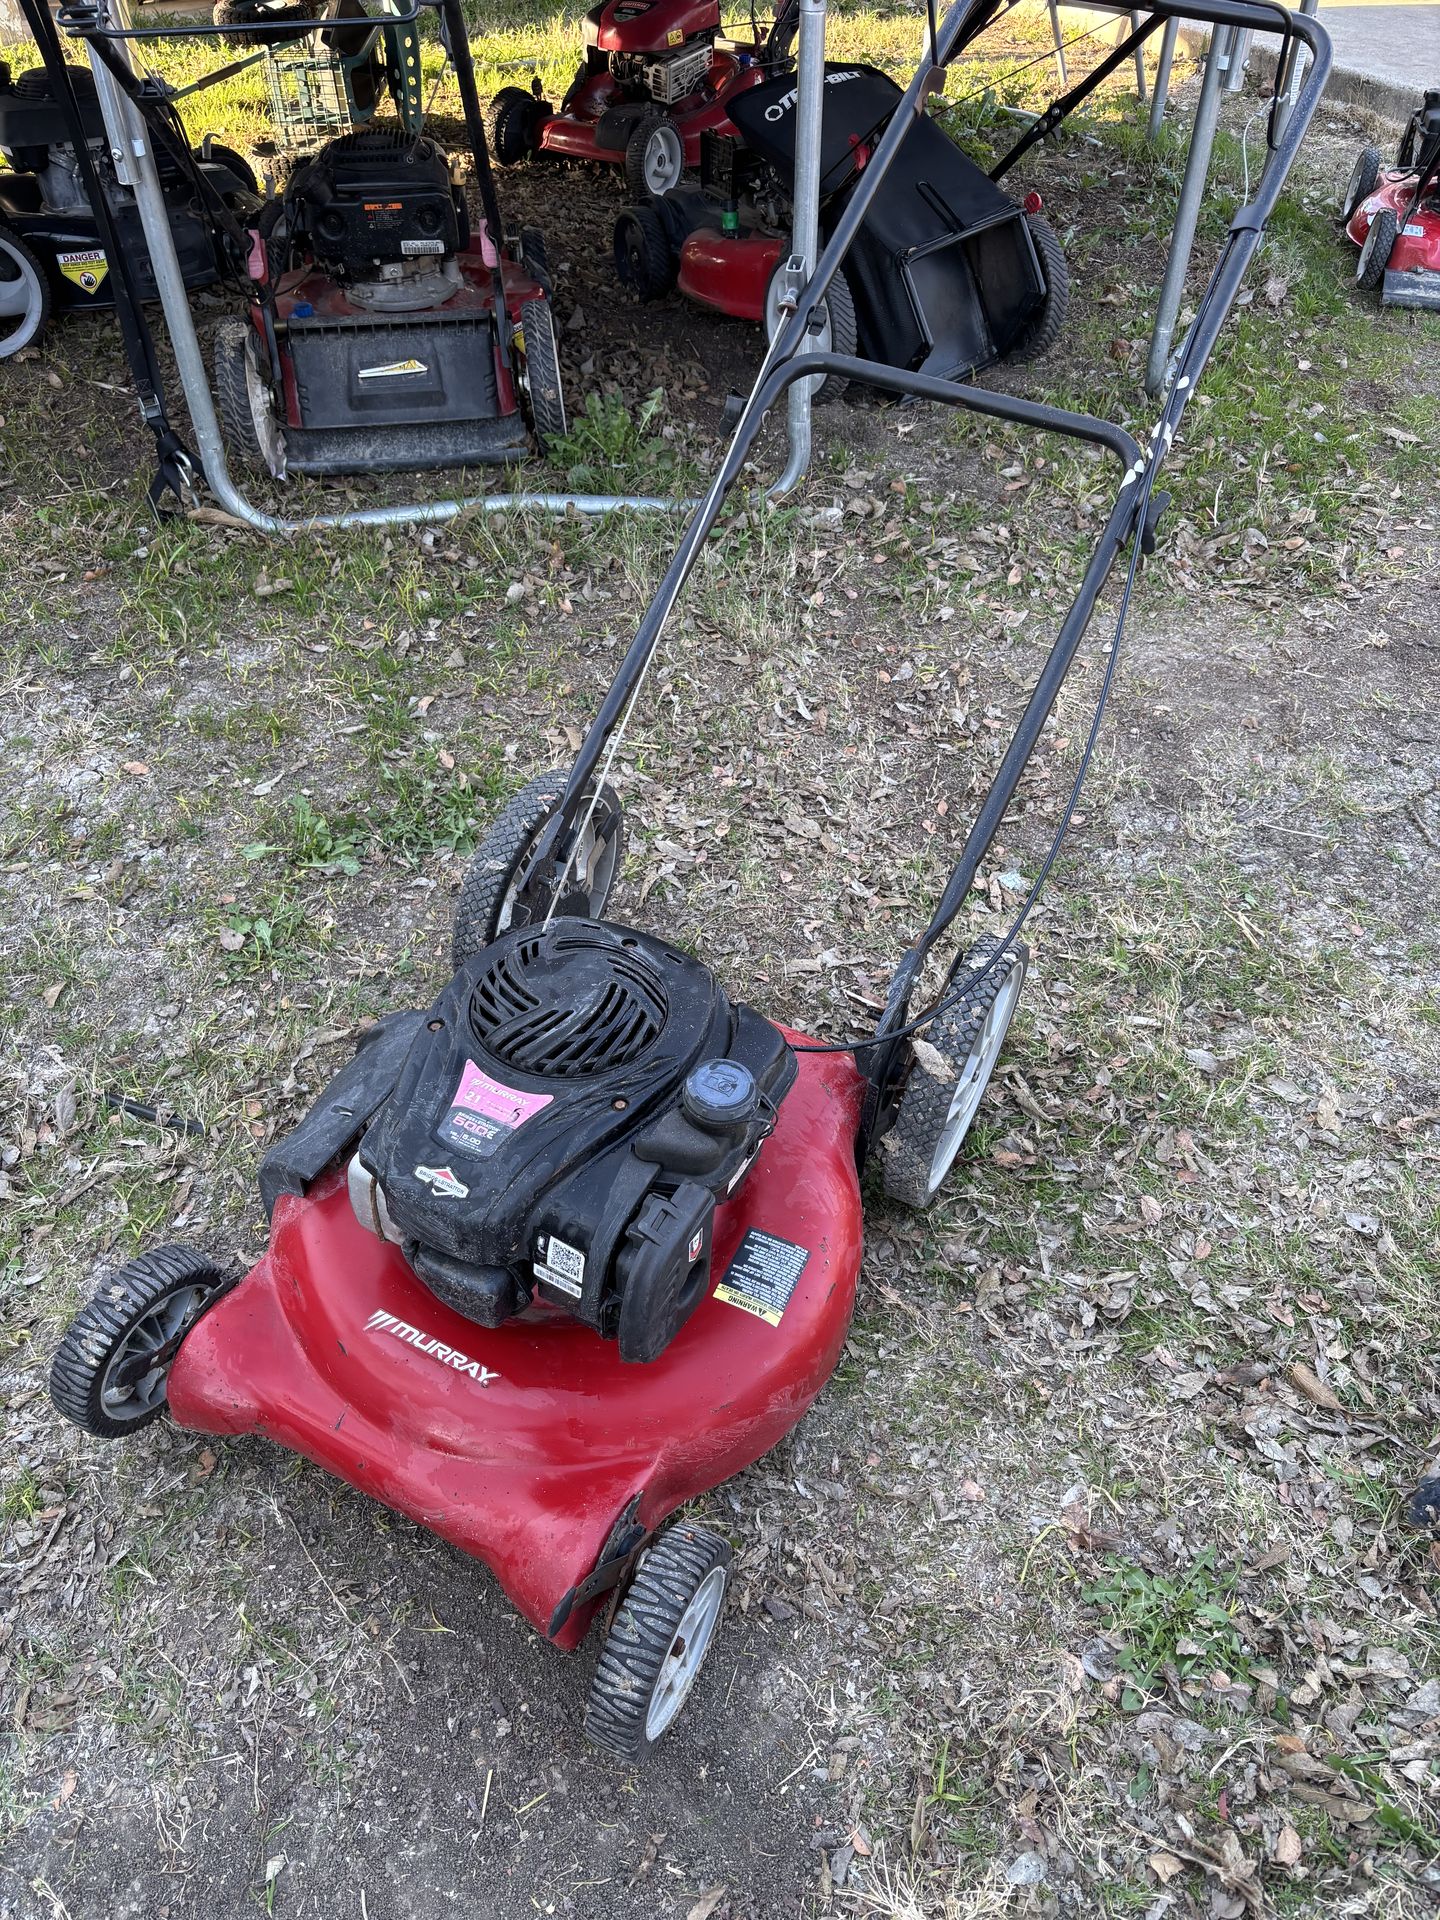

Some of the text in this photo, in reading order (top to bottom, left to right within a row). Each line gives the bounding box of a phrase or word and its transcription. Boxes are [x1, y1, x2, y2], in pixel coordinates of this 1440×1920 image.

[779, 71, 861, 110] TR-BILT
[62, 252, 101, 263] DANGER
[464, 1091, 481, 1104] 21
[481, 1083, 530, 1106] MURRAY
[727, 1294, 757, 1312] WARNING
[390, 1321, 500, 1384] MURRAY
